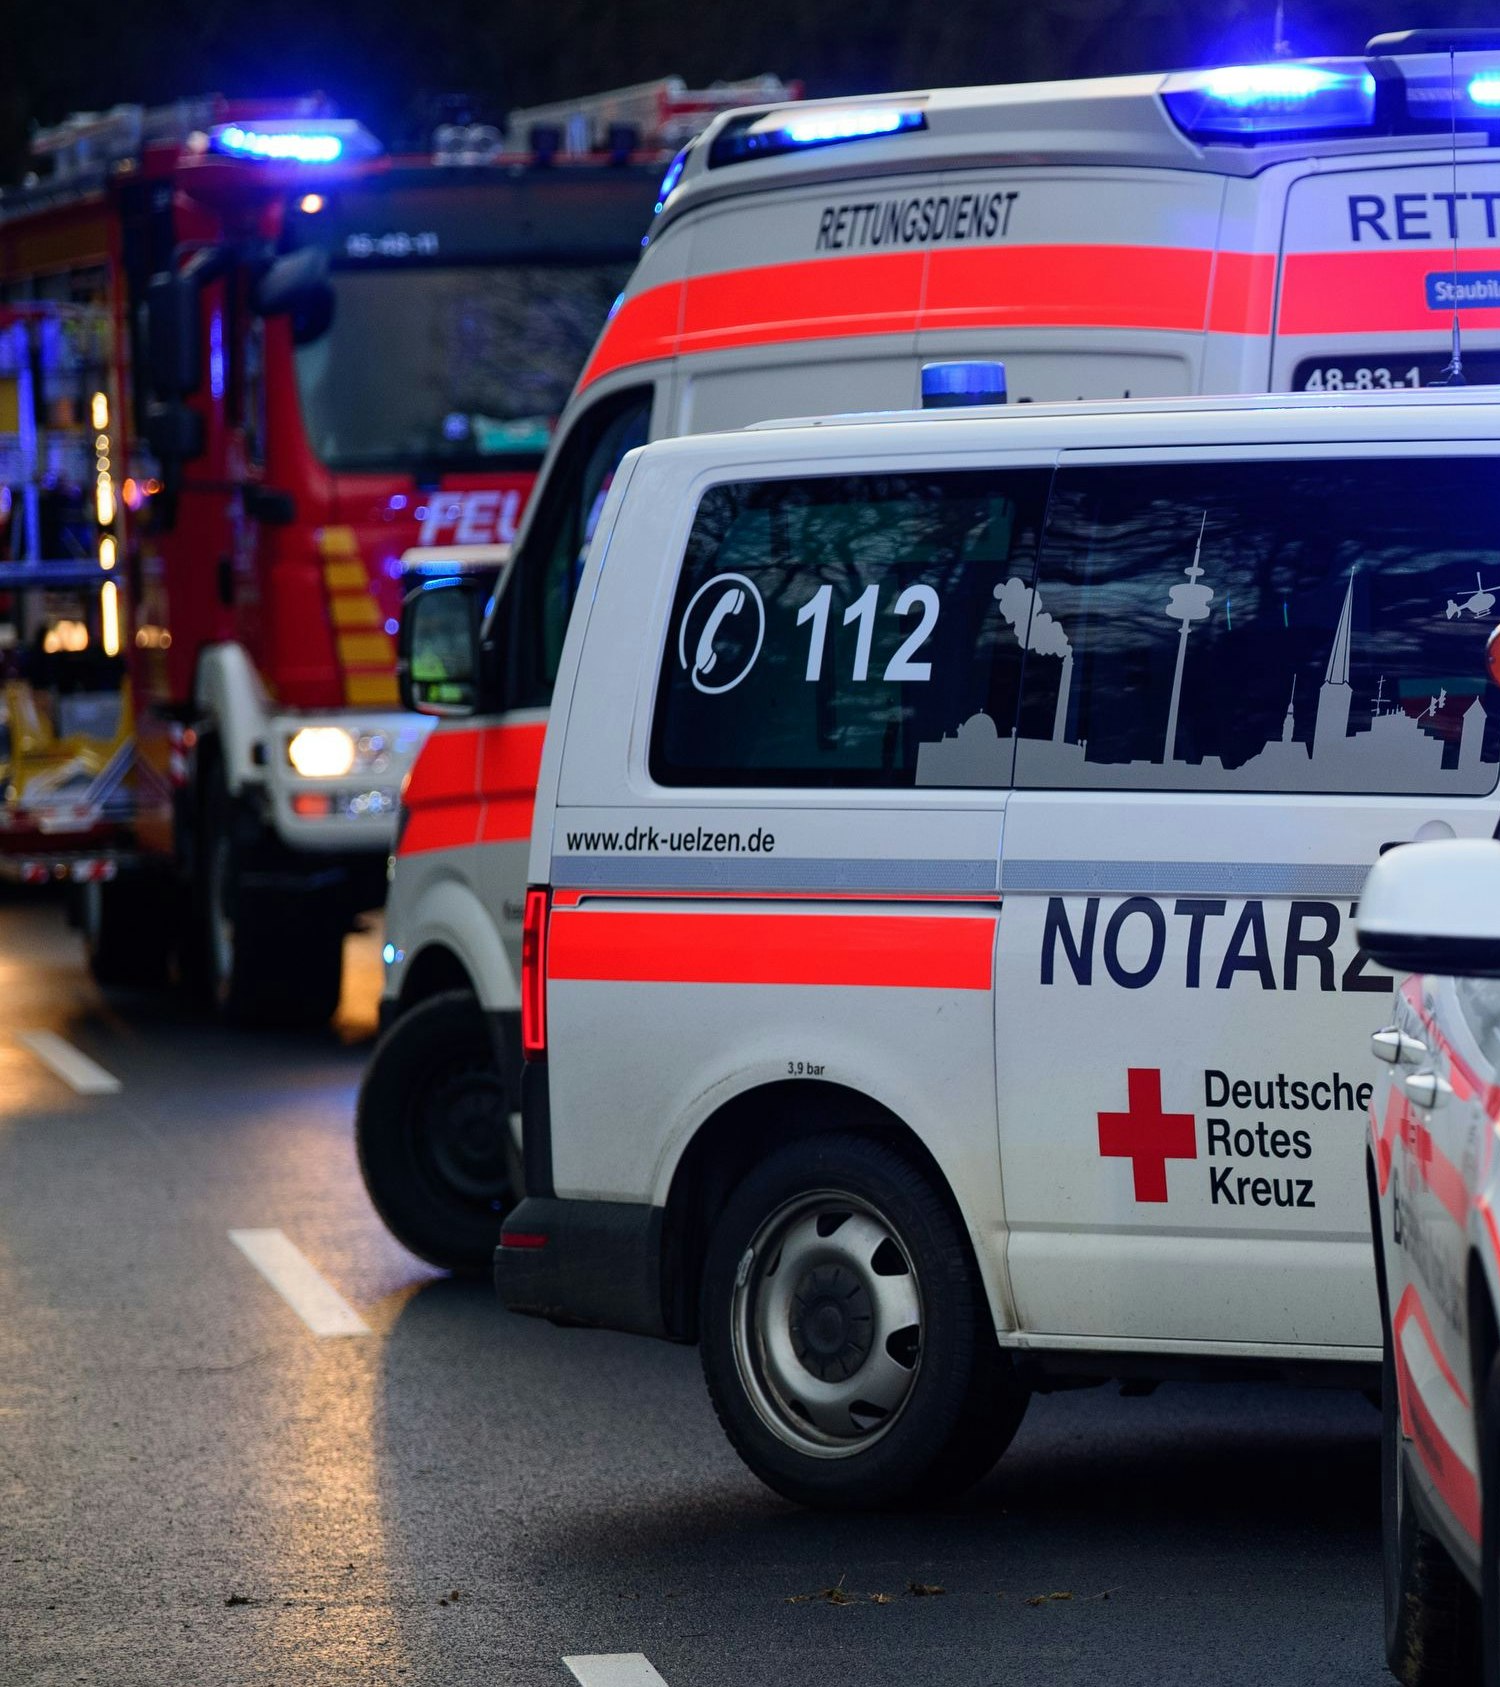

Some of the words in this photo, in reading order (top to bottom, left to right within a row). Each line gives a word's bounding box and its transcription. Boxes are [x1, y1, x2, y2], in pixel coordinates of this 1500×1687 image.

[816, 191, 1018, 250] RETTUNGSDIENST
[1304, 366, 1421, 392] 48-83-1
[796, 584, 940, 683] 112
[566, 826, 775, 856] www.drk-uelzen.de
[787, 1060, 804, 1077] 3,9
[806, 1060, 826, 1076] bar
[1204, 1069, 1373, 1112] Deutsche
[1206, 1118, 1312, 1160] Rotes
[1208, 1166, 1316, 1208] Kreuz
